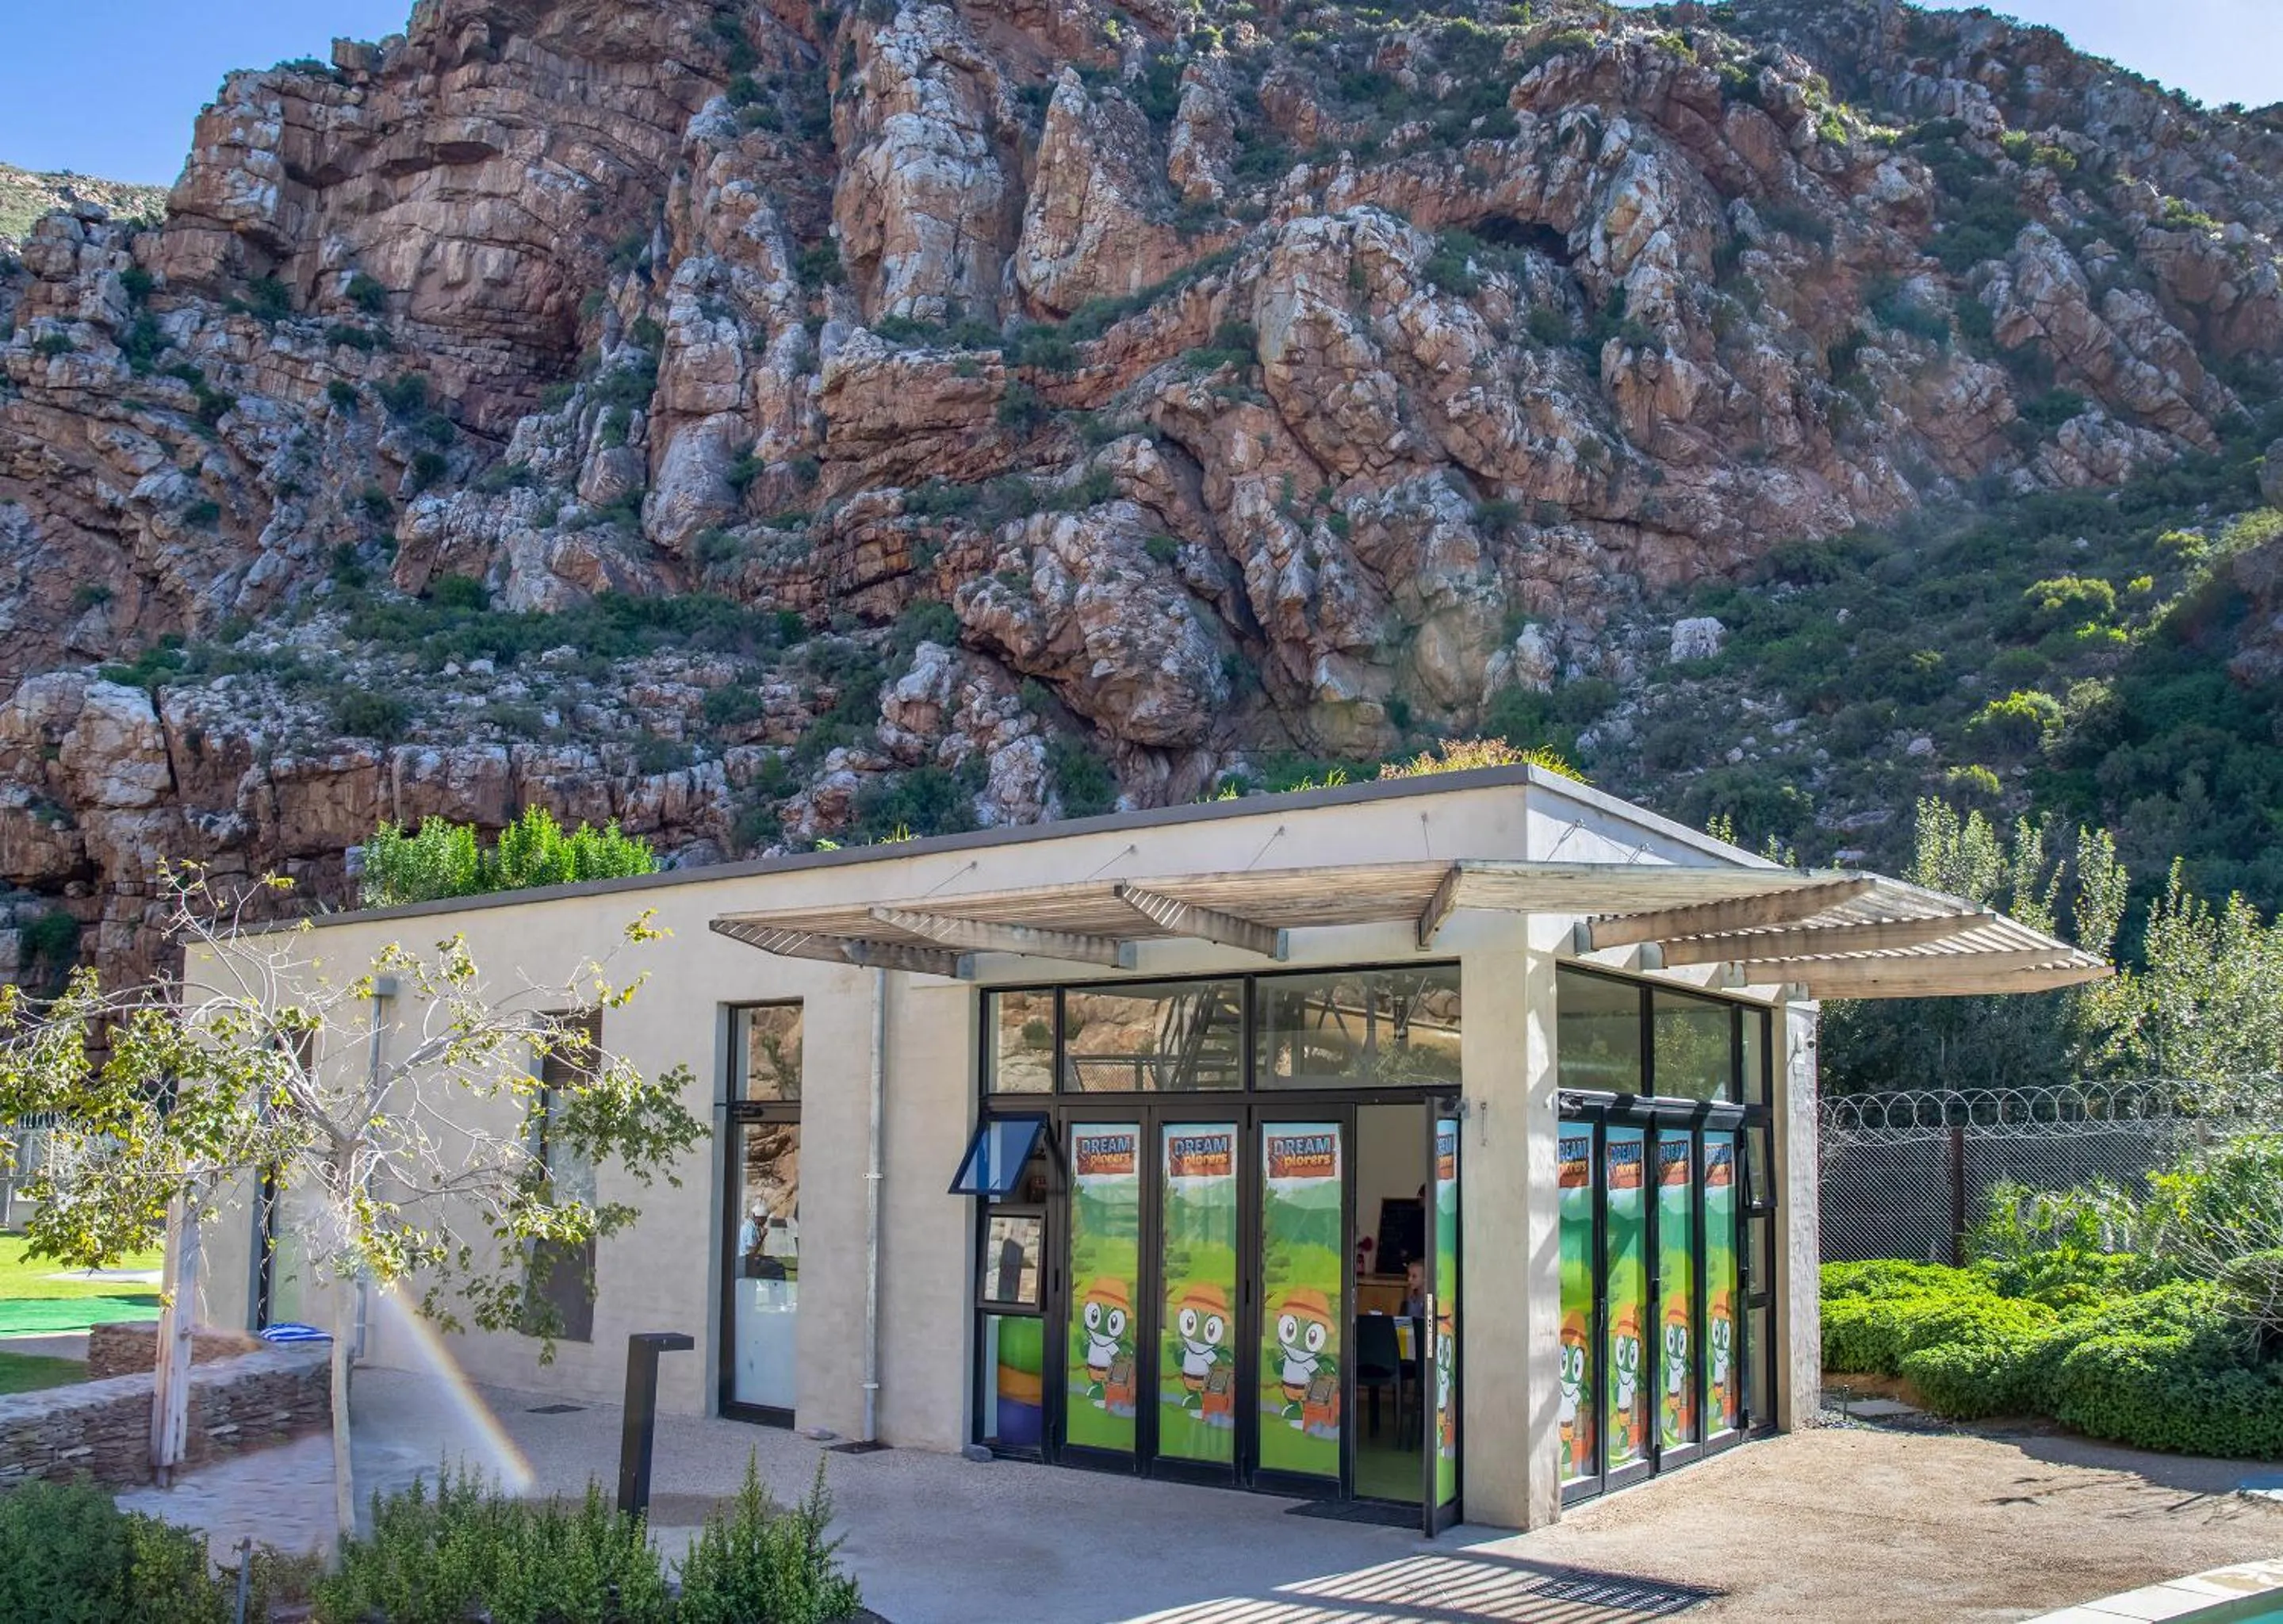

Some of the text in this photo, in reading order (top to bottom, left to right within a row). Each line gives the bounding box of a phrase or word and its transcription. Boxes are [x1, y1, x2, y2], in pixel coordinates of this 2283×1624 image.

[1081, 1136, 1130, 1155] DREAM
[1174, 1136, 1228, 1156] DREAM
[1274, 1136, 1331, 1156] DREAM
